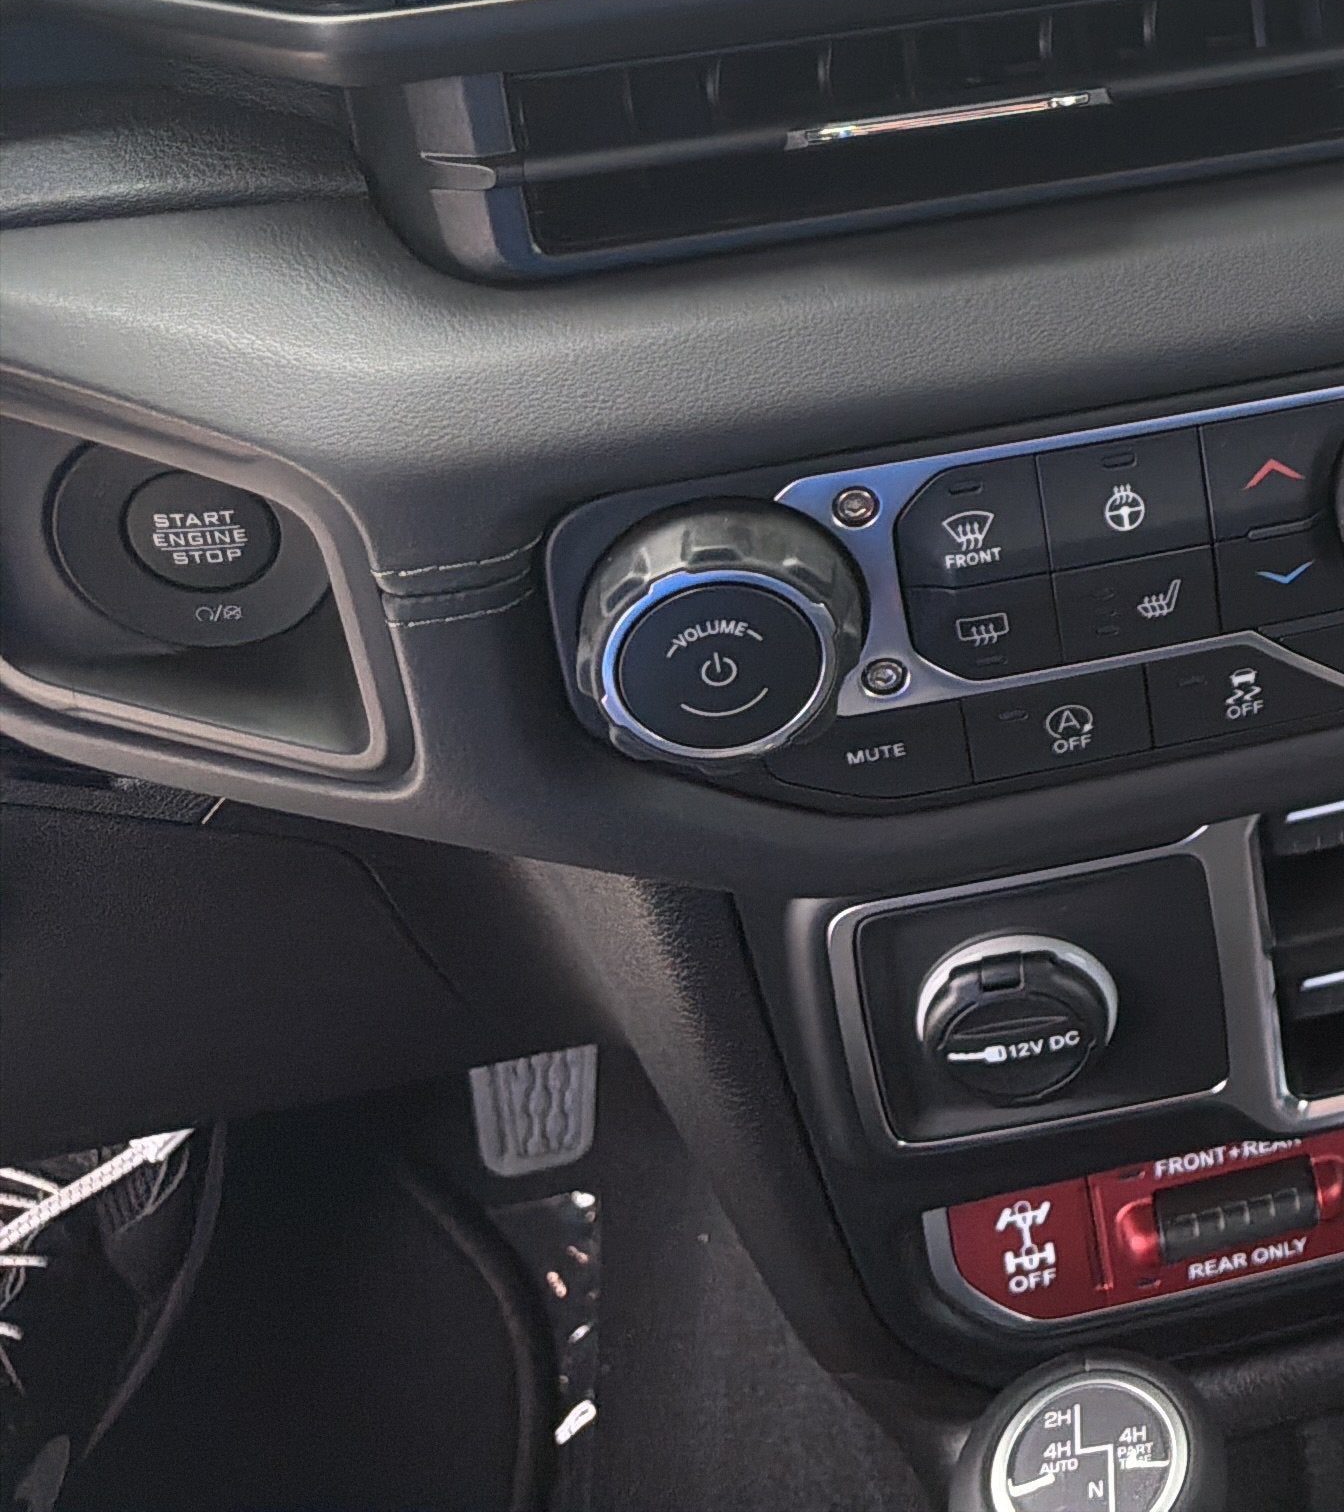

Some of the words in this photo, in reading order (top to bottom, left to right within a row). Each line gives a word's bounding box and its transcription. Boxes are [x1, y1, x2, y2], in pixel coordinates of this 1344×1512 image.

[152, 510, 235, 528] START
[152, 528, 249, 547] ENGINE
[172, 548, 242, 565] STOP
[945, 545, 1001, 570] FRONT
[671, 619, 749, 649] VOLUME
[1226, 699, 1265, 720] OFF
[846, 742, 907, 766] MUTE
[1052, 733, 1093, 754] OFF
[1008, 1038, 1045, 1059] 12V
[1048, 1029, 1081, 1053] DC
[1188, 1251, 1249, 1281] REAR
[1250, 1236, 1308, 1265] ONLY
[1009, 1267, 1058, 1294] OFF
[1043, 1408, 1072, 1429] 2H
[1118, 1424, 1147, 1444] 4H
[1042, 1439, 1072, 1460] 4H
[1038, 1457, 1079, 1476] AUTO
[1088, 1479, 1104, 1499] N
